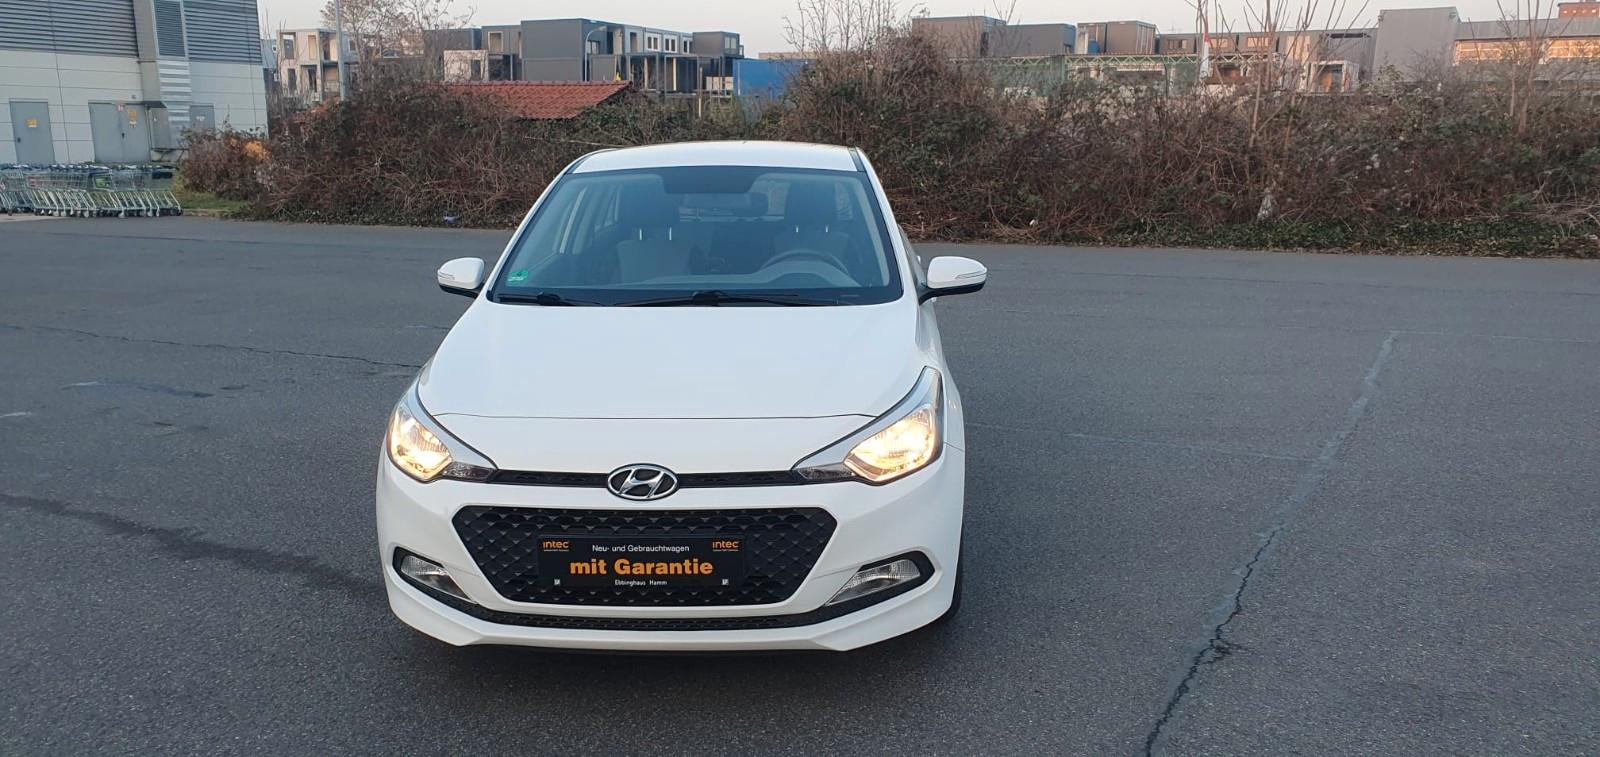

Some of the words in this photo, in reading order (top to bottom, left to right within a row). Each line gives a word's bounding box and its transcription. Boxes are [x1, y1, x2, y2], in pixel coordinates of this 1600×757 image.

[627, 545, 689, 553] Gebrauchtwagen
[570, 558, 607, 575] mit
[614, 558, 714, 575] Garantie
